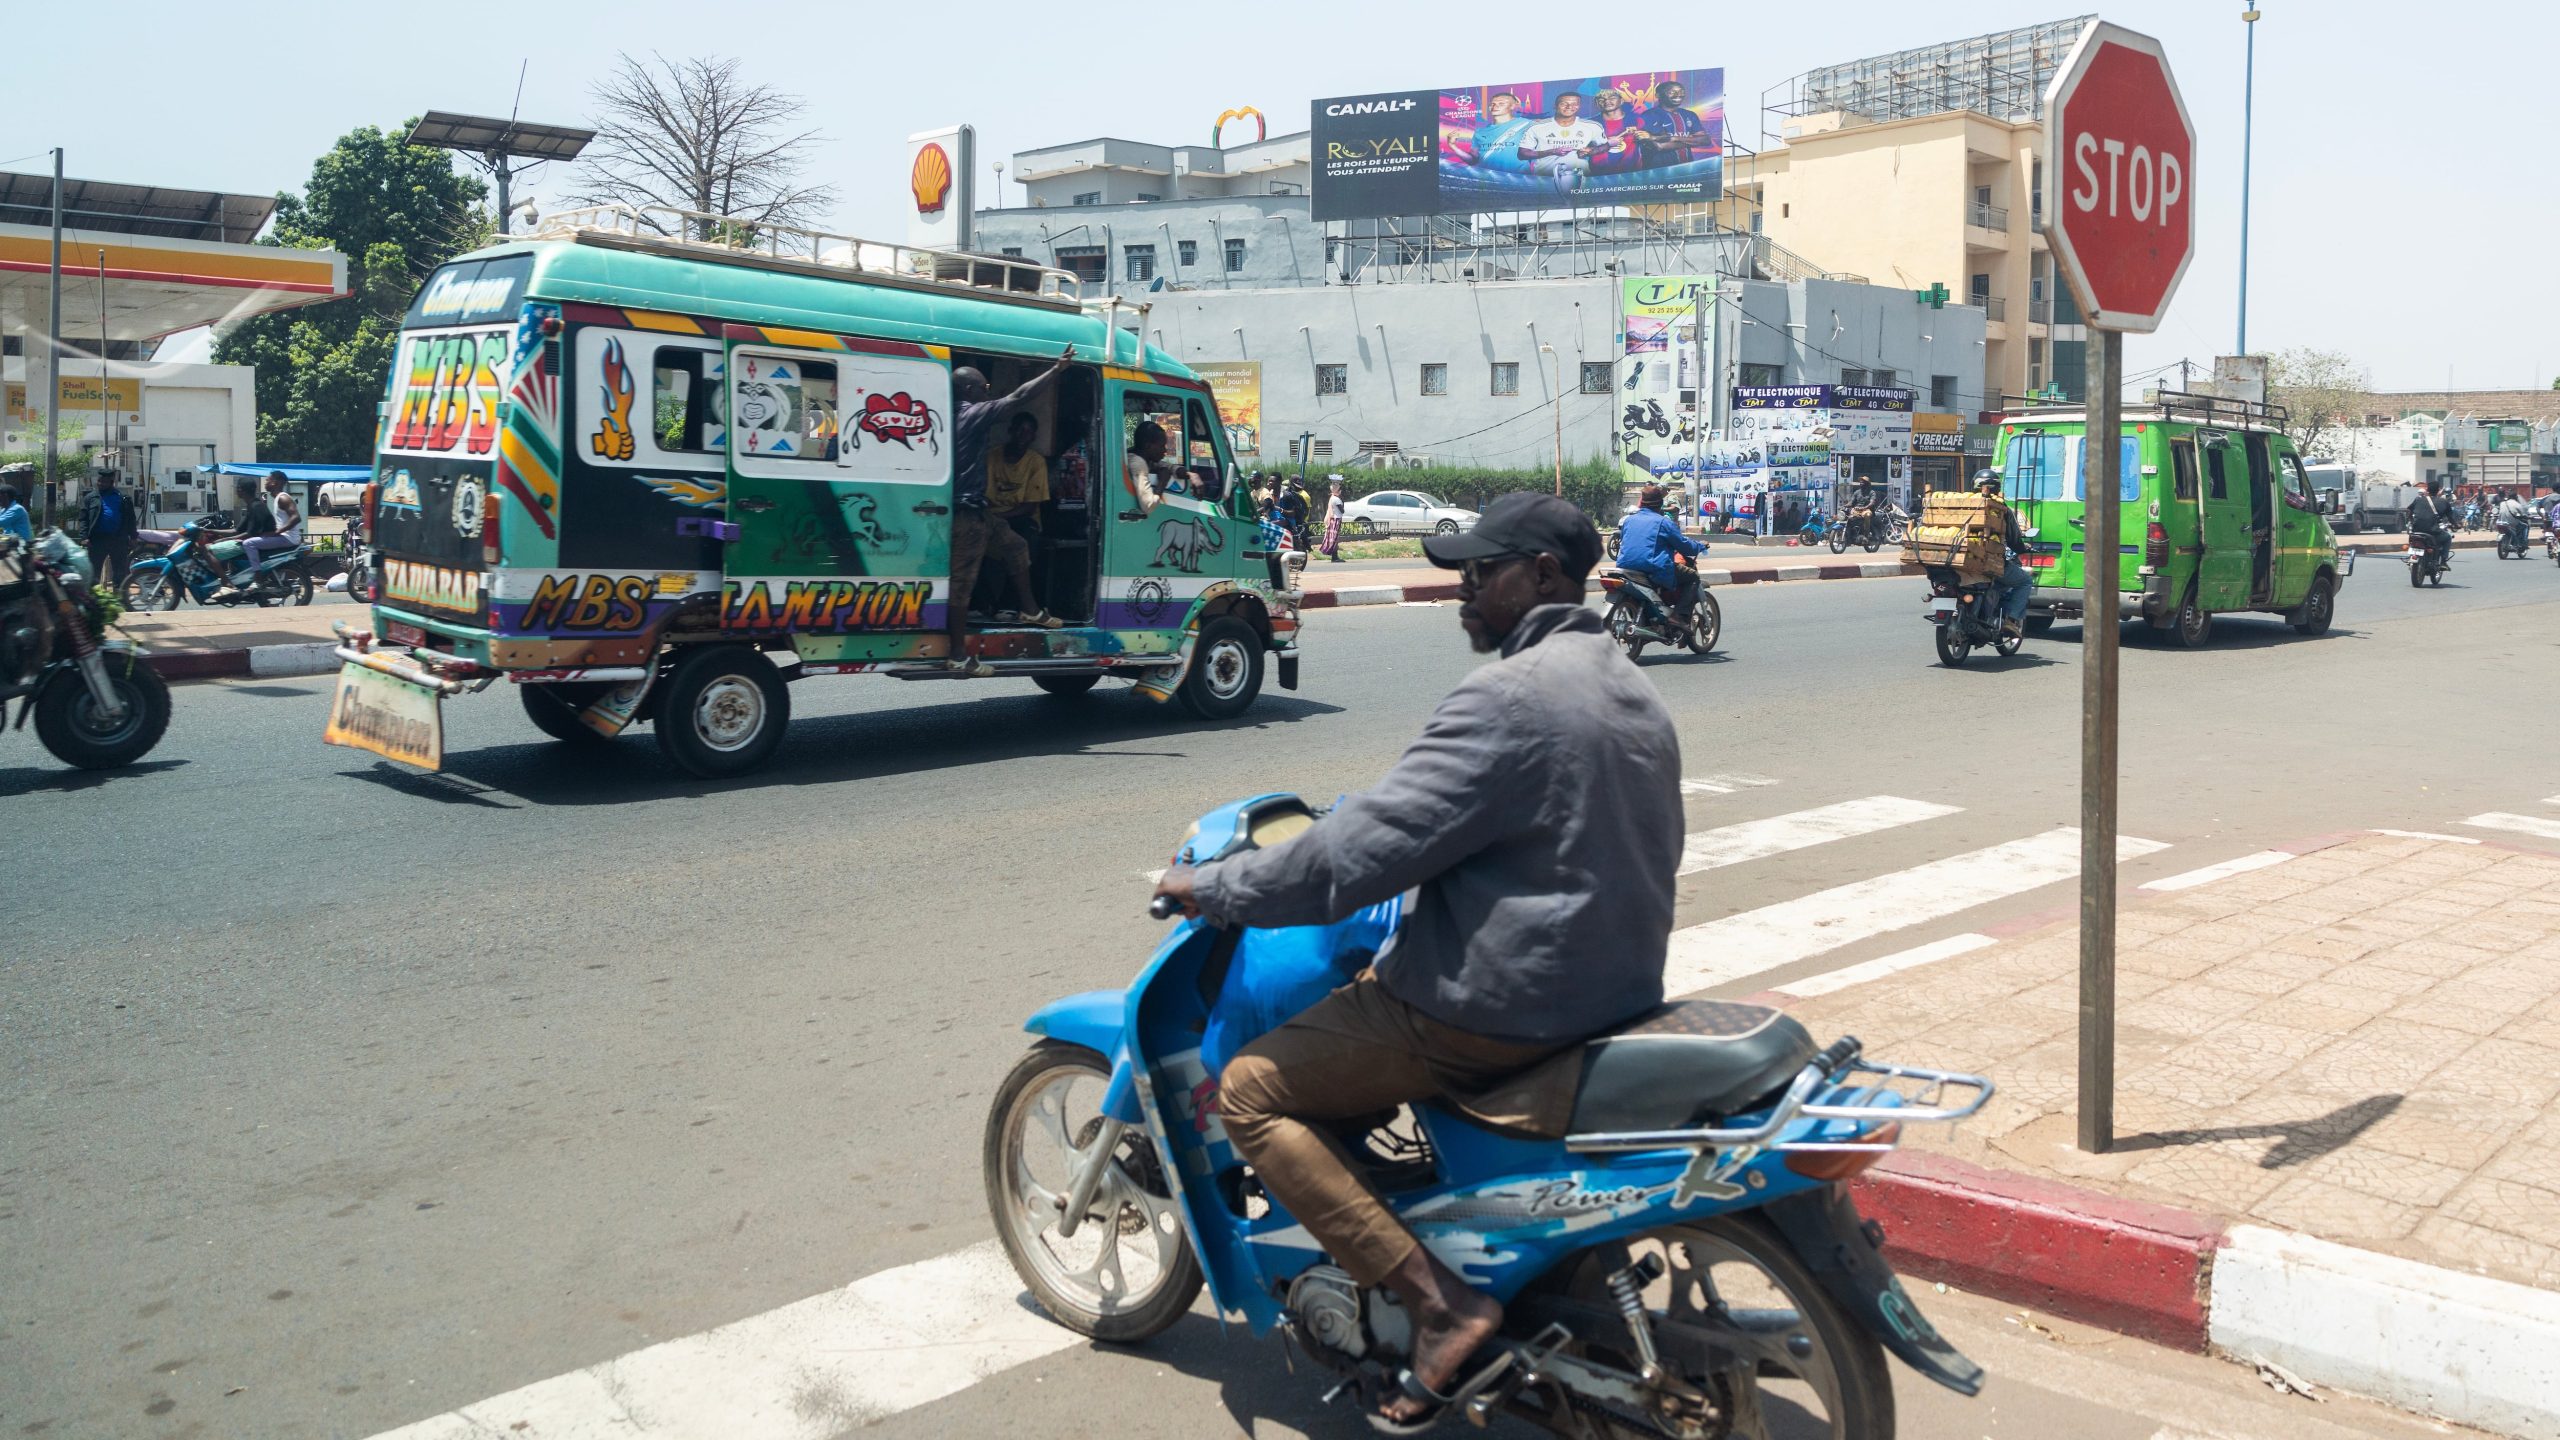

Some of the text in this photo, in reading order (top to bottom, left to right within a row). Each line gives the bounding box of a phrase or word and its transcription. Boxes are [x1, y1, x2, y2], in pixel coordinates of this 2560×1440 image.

[1326, 99, 1416, 116] CANAL+
[1344, 160, 1366, 168] ROIS
[1369, 158, 1380, 166] DE
[1383, 155, 1429, 165] L'EUROPE
[1355, 165, 1411, 175] ATTENDENT
[2072, 131, 2182, 227] STOP
[1606, 185, 1648, 193] MERCREDIS
[1667, 182, 1702, 190] CANAL+
[1226, 369, 1252, 377] mondial
[391, 331, 508, 454] MBS
[1738, 387, 1821, 397] TMT ELECTRONIQUE
[1868, 401, 1878, 409] 4G
[1912, 433, 1942, 446] CYBER
[1973, 438, 1986, 449] YELI
[1766, 444, 1829, 453] TT ELECTRONIQUE
[1703, 492, 1743, 500] SAMUNG
[520, 574, 654, 631] MBS
[1529, 1180, 1652, 1214] Power
